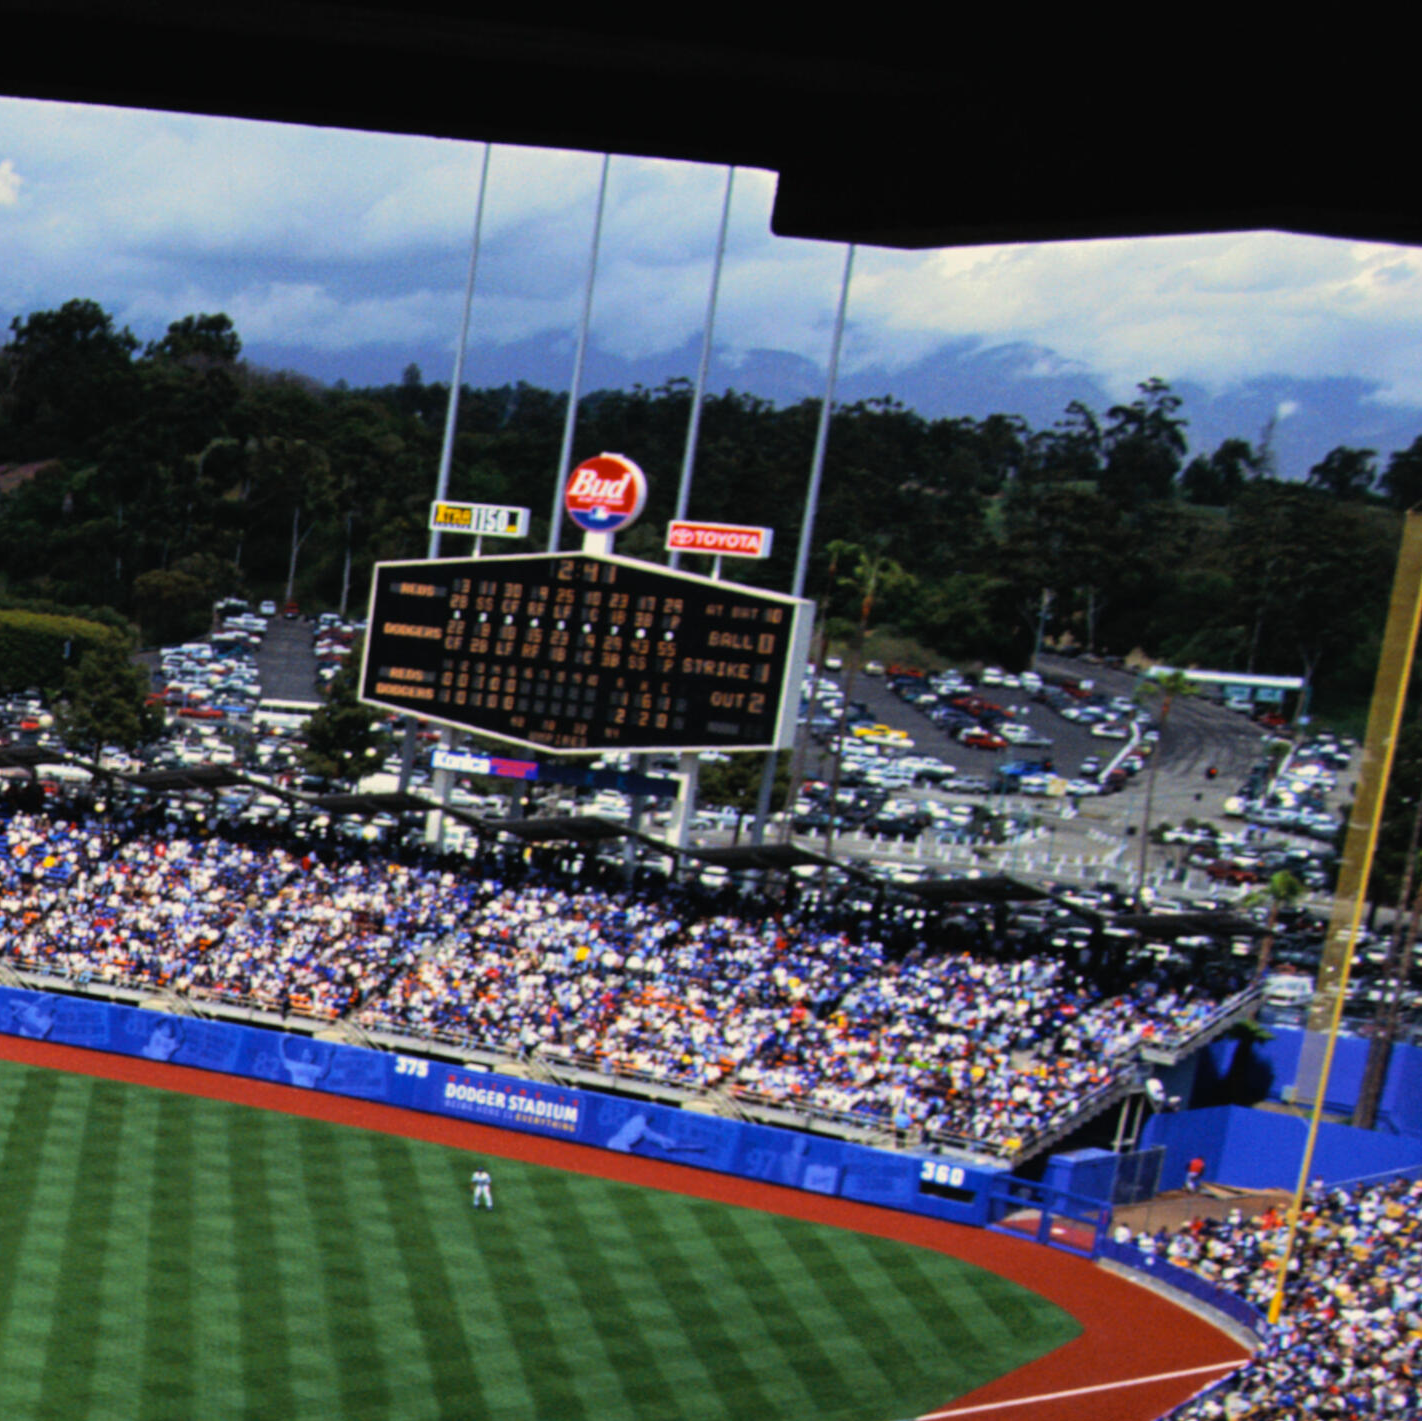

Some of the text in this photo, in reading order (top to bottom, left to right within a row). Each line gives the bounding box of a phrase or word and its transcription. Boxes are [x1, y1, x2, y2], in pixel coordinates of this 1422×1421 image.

[568, 469, 631, 498] Bud
[471, 508, 508, 531] 1150
[696, 530, 759, 549] TOYOTA
[557, 559, 617, 584] 2:41
[400, 582, 435, 597] REDS
[609, 593, 629, 609] 23
[501, 599, 520, 614] CF
[553, 604, 572, 619] LF
[589, 607, 599, 622] C
[670, 614, 681, 630] P
[383, 621, 442, 639] DODGERS
[708, 630, 776, 655] BALL 0
[444, 635, 463, 650] CF
[495, 640, 514, 656] LF
[583, 650, 593, 665] C
[663, 658, 675, 673] P
[389, 666, 423, 682] REDS
[441, 671, 454, 687] 0
[457, 673, 469, 688] 0
[489, 676, 501, 691] 0
[505, 678, 517, 693] 0
[682, 657, 771, 684] STRIKE 1
[375, 681, 435, 700] DODGERS
[455, 689, 467, 705] 0
[486, 693, 498, 708] 0
[503, 695, 515, 711] 0
[614, 707, 626, 724] 2
[637, 711, 650, 727] 2
[656, 712, 668, 728] 0
[710, 691, 766, 714] OUT 2
[433, 750, 491, 774] Konica
[395, 1056, 429, 1077] 375
[445, 1083, 578, 1122] DODGER STADIUM
[515, 1113, 575, 1132] EVERYTHING
[920, 1161, 965, 1187] 360
